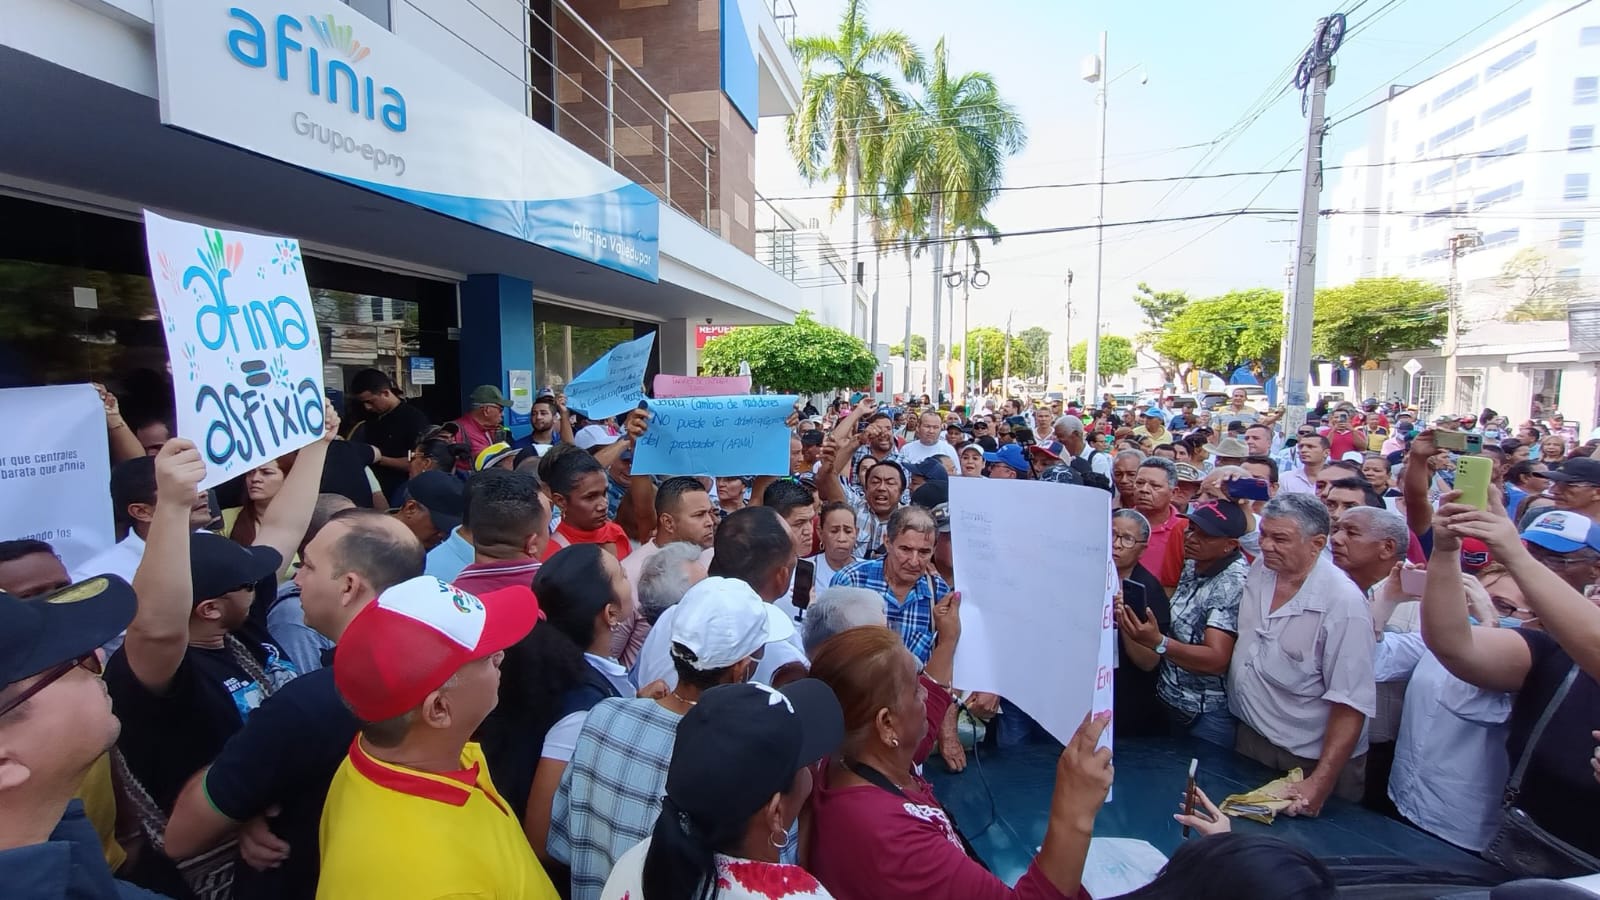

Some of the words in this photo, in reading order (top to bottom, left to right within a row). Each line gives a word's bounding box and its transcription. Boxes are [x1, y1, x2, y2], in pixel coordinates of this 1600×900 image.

[226, 7, 407, 133] afinia
[573, 220, 607, 249] Oficina
[610, 233, 652, 265] Valledupar
[196, 377, 325, 465] asfixia
[651, 411, 671, 426] NO
[1, 467, 36, 480] barata
[39, 465, 57, 476] que
[59, 461, 86, 473] afinia
[10, 455, 31, 466] que
[34, 450, 78, 464] centrales
